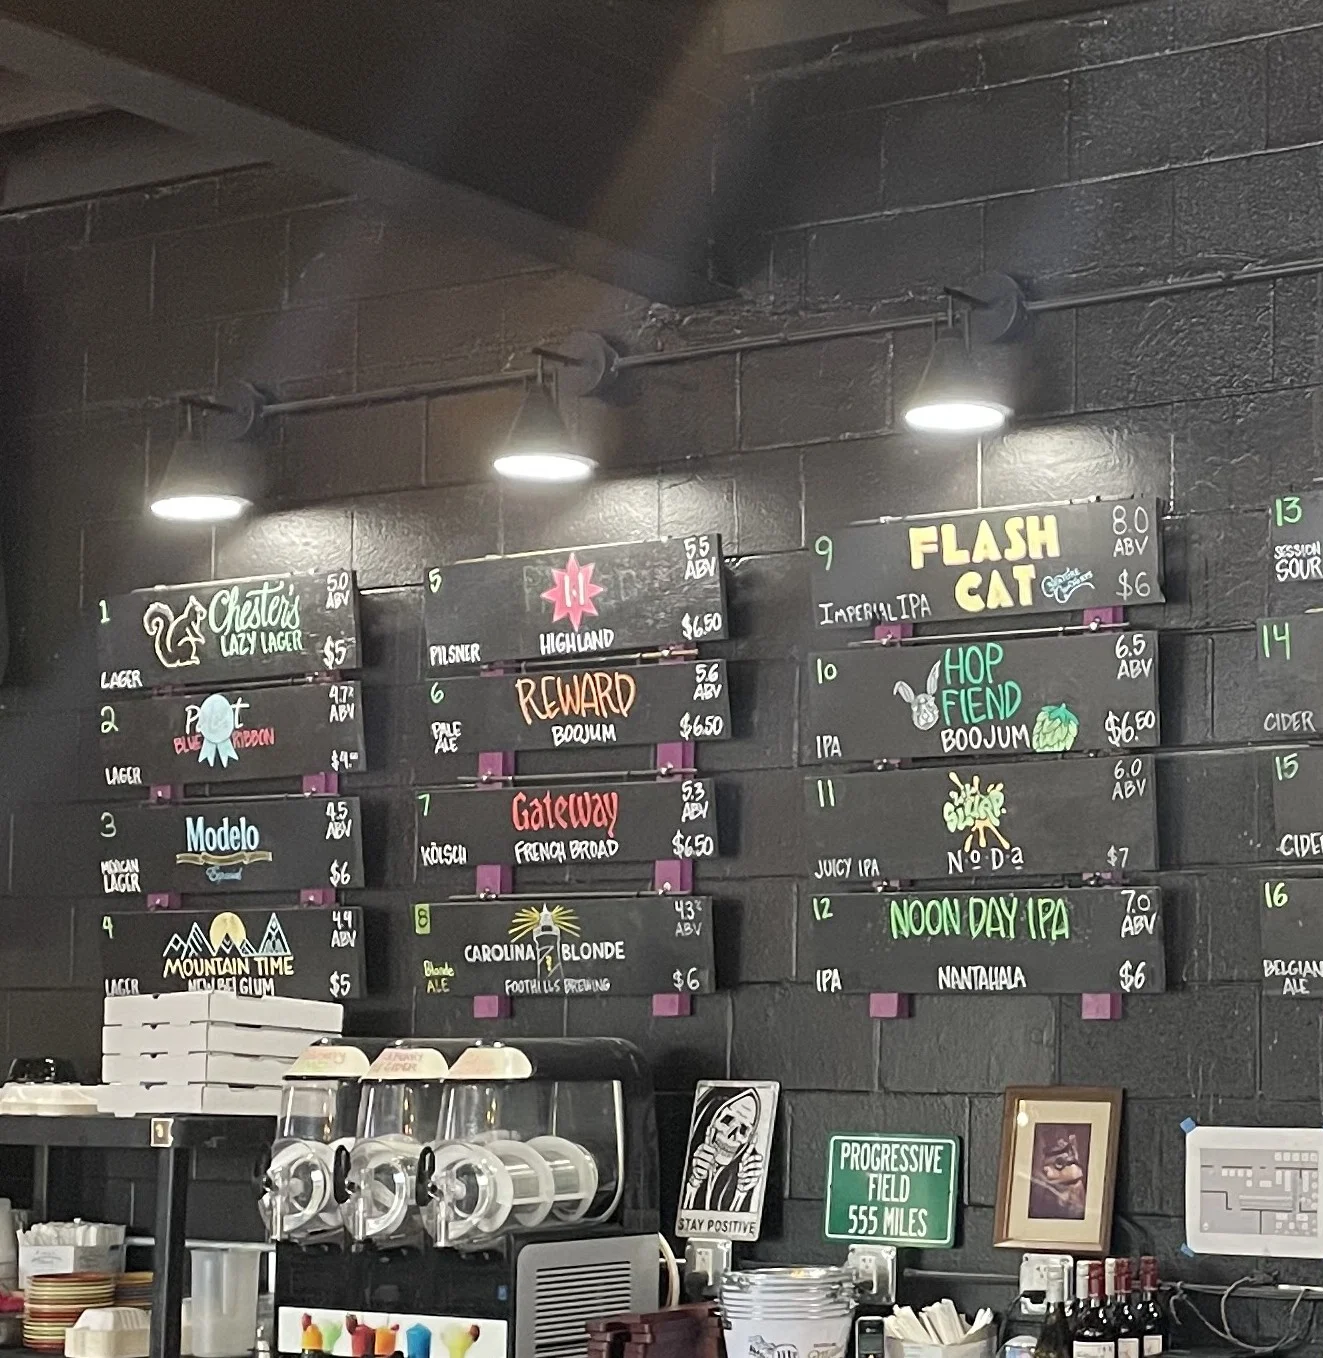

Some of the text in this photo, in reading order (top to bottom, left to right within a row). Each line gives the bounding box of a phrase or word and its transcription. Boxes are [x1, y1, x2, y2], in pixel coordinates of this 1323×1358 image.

[1113, 505, 1149, 535] 8.0
[1275, 497, 1302, 526] 13
[814, 535, 833, 571] 9
[909, 514, 1061, 570] FLASH
[1113, 536, 1149, 557] ABV
[1274, 541, 1321, 559] SESSION
[685, 557, 716, 580] ABV
[1275, 557, 1323, 581] SOUR
[954, 564, 1037, 612] CAT
[1116, 568, 1150, 600] $6
[208, 581, 300, 635] Chester's
[326, 590, 350, 610] ABV
[682, 612, 722, 640] $6.50
[539, 628, 615, 655] HIGHLAND
[1115, 634, 1146, 659] 6.5
[1261, 623, 1290, 660] 14
[430, 643, 481, 666] PILSNER
[944, 642, 1004, 685] HOP
[101, 670, 143, 689] LAGER
[1117, 658, 1153, 680] ABV
[515, 671, 636, 725] REWARD
[693, 683, 722, 700] ABV
[942, 680, 1022, 725] FIEND
[101, 706, 118, 733] 2
[330, 703, 355, 722] ABV
[1263, 710, 1316, 732] CIDER
[431, 721, 461, 739] PALE
[551, 724, 617, 746] BOOJUM
[680, 711, 724, 741] $6.50
[940, 724, 1030, 752] BOOJUM
[1105, 710, 1156, 747] $6.50
[434, 737, 458, 754] ALE
[816, 735, 842, 759] IPA
[105, 767, 142, 785] LAGER
[1114, 758, 1142, 779] 6.0
[1274, 753, 1299, 780] 15
[682, 780, 705, 802] 5.3
[1112, 779, 1147, 801] ABV
[512, 791, 618, 839] Gateway
[681, 801, 709, 822] ABV
[101, 812, 117, 837] 3
[186, 817, 259, 851] Modelo
[421, 842, 467, 866] KÖLSCH
[514, 839, 619, 864] FRENCH BROAD
[1107, 845, 1129, 868] $7
[330, 859, 350, 887] $6
[815, 858, 852, 878] JUICY
[104, 874, 141, 892] LAGER
[1121, 890, 1151, 913] 7.0
[1264, 882, 1288, 909] 16
[813, 897, 833, 921] 12
[891, 897, 1069, 940] NOON DAY IPA
[675, 922, 703, 937] ABV
[1121, 913, 1156, 938] ABV
[331, 930, 356, 947] ABV
[464, 941, 626, 963] CAROLINA BLONDE
[163, 957, 294, 979] MOUNTAIN TIME
[938, 966, 1026, 990] NANTAHALA
[1119, 960, 1146, 992] $6
[1263, 960, 1323, 978] BELGIAN
[330, 971, 350, 997] $5
[427, 978, 450, 993] ALE
[505, 978, 610, 995] FOOTHILLS BREWING
[816, 969, 842, 992] IPA
[840, 1142, 944, 1174] PROGRESSIVE
[867, 1174, 910, 1203] FIELD
[678, 1217, 756, 1234] STAY POSITIVE
[848, 1206, 928, 1237] 555 MILES
